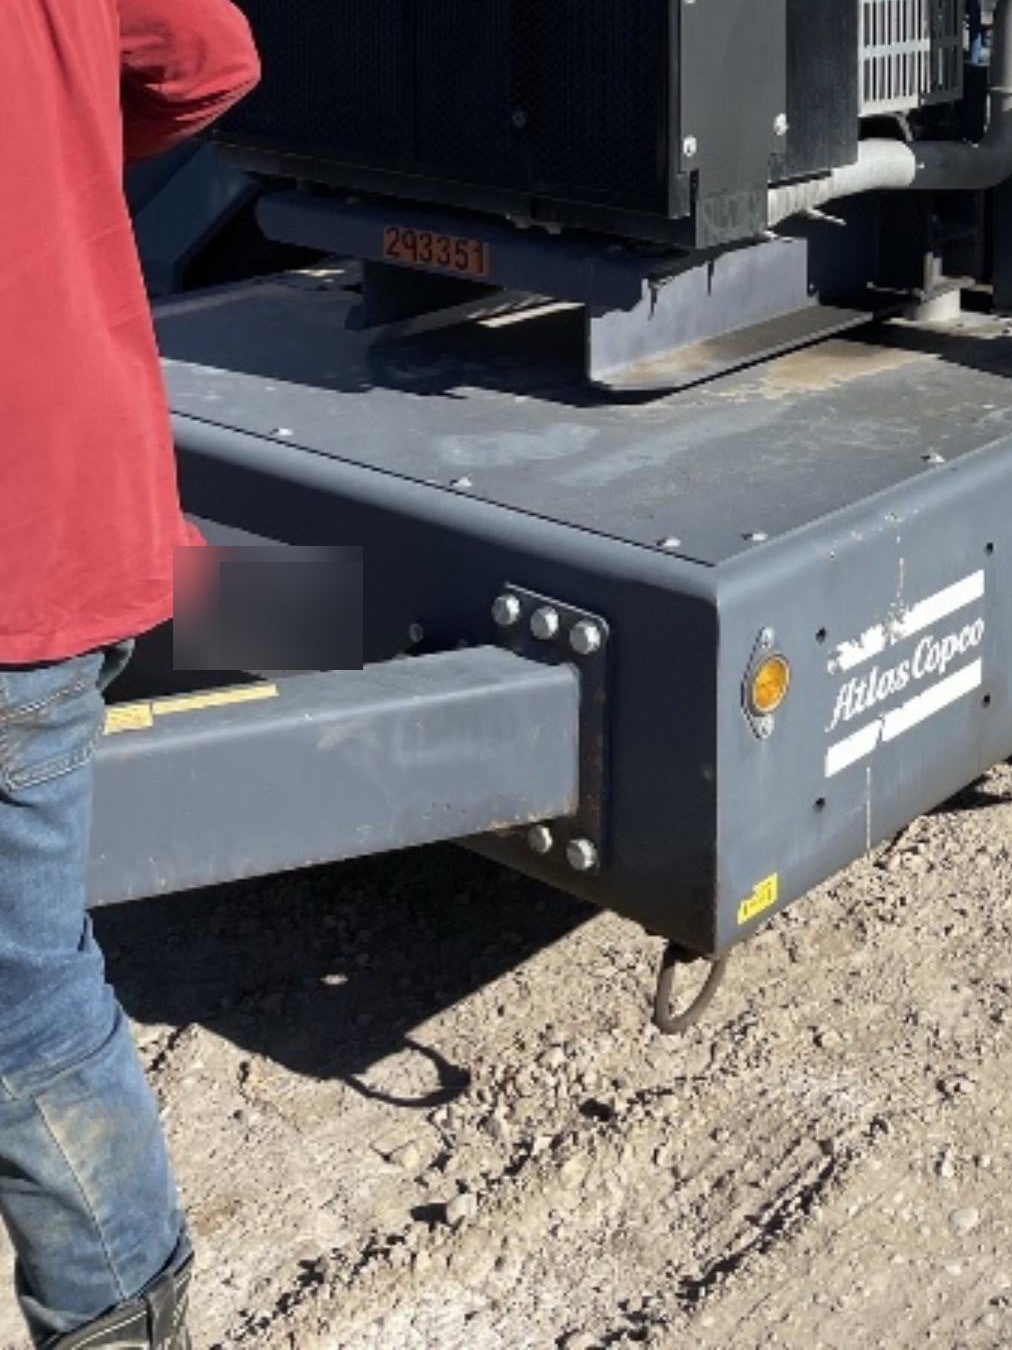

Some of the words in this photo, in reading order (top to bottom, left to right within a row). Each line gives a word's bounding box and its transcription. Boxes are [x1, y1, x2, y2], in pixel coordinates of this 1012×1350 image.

[385, 227, 485, 275] 293351
[824, 659, 911, 733] Atlas
[912, 616, 985, 680] Copco
